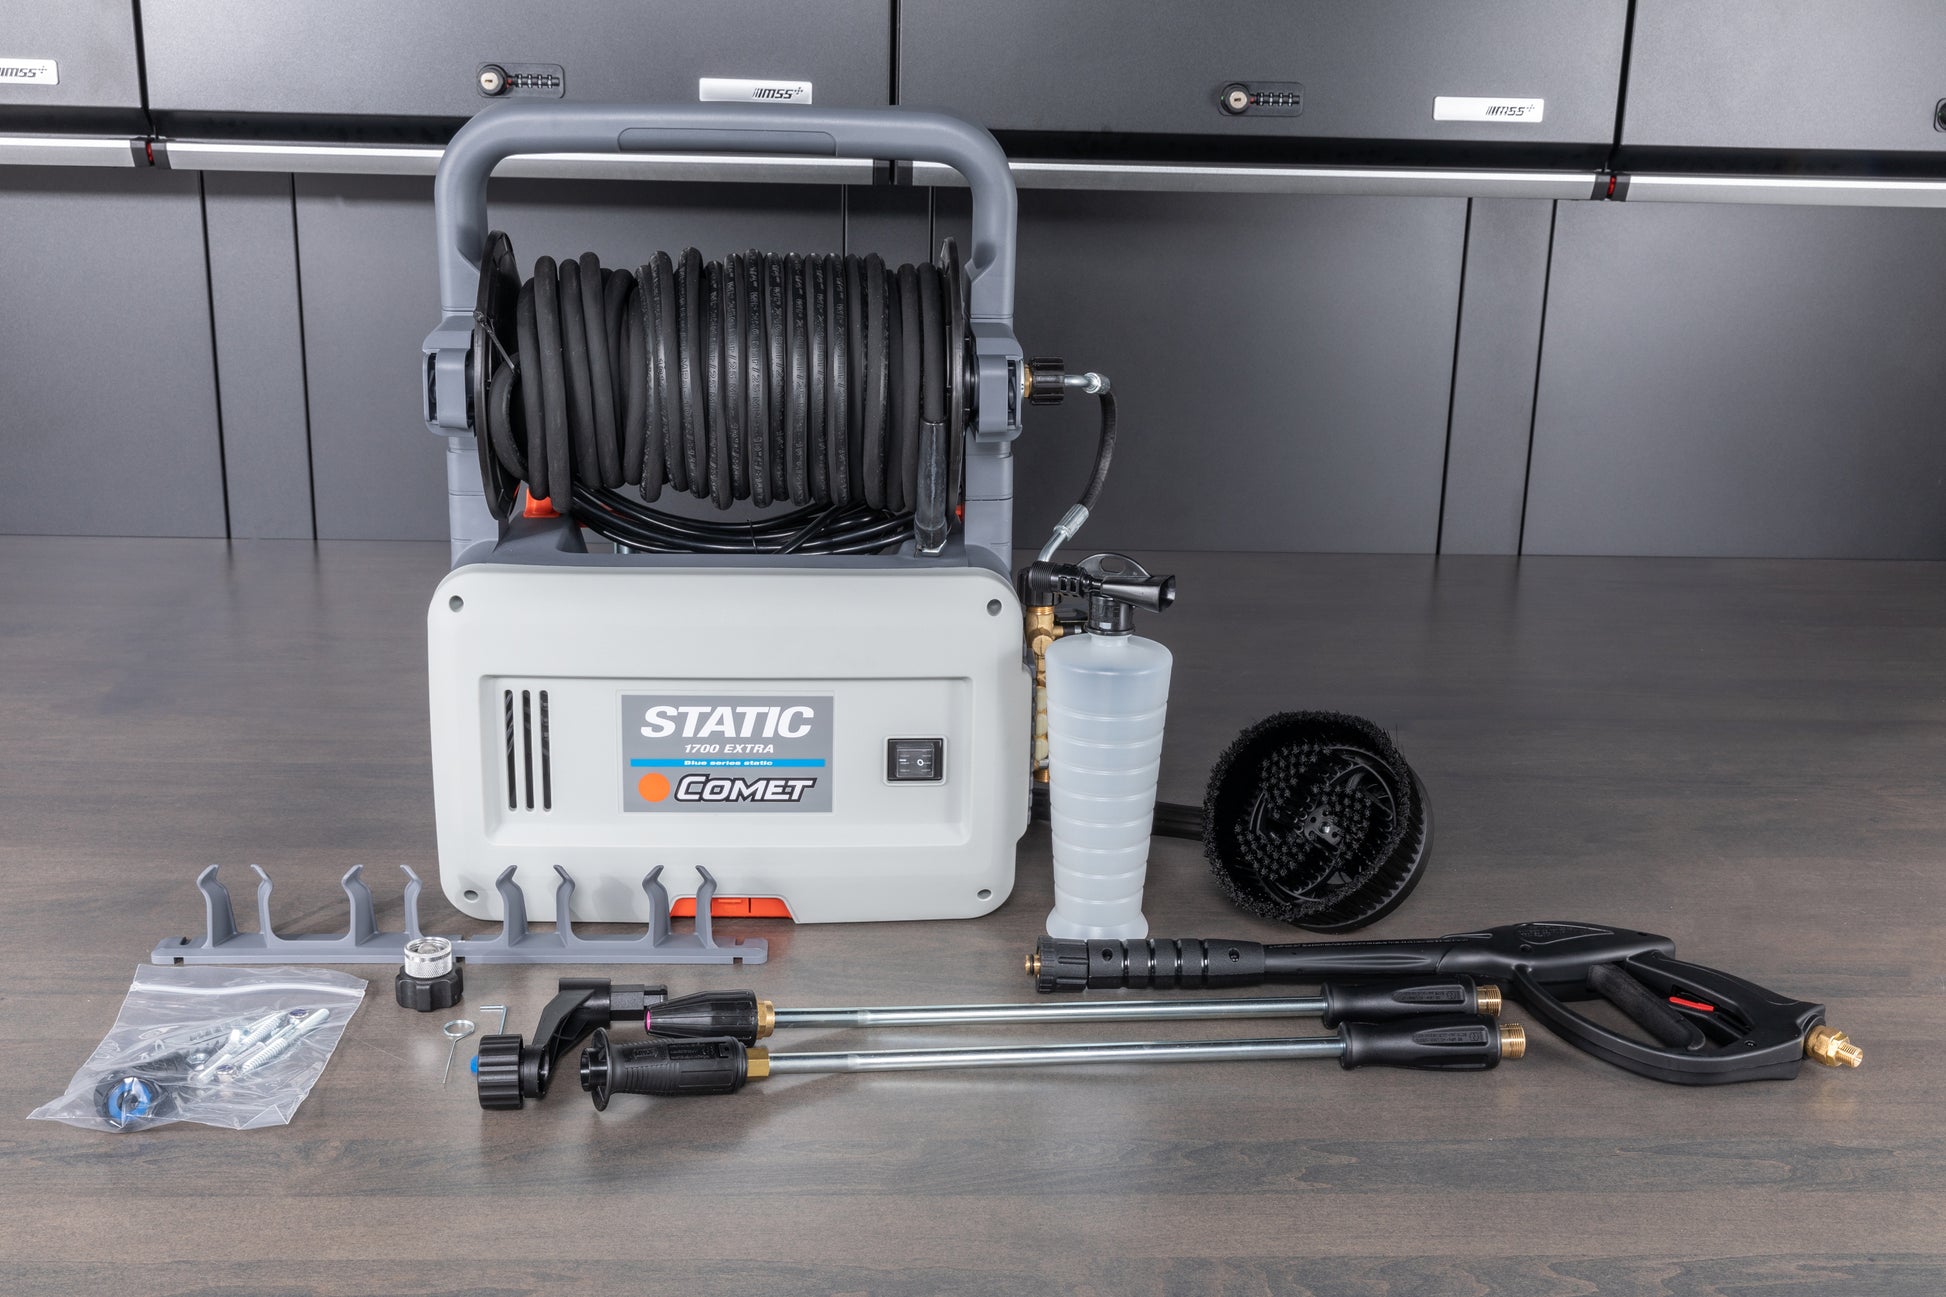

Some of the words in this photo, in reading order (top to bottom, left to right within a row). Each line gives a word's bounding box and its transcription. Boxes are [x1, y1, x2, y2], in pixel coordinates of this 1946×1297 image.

[640, 705, 815, 738] STATIC
[684, 743, 720, 754] 1700
[723, 743, 774, 754] EXTRA
[674, 773, 817, 802] COMET
